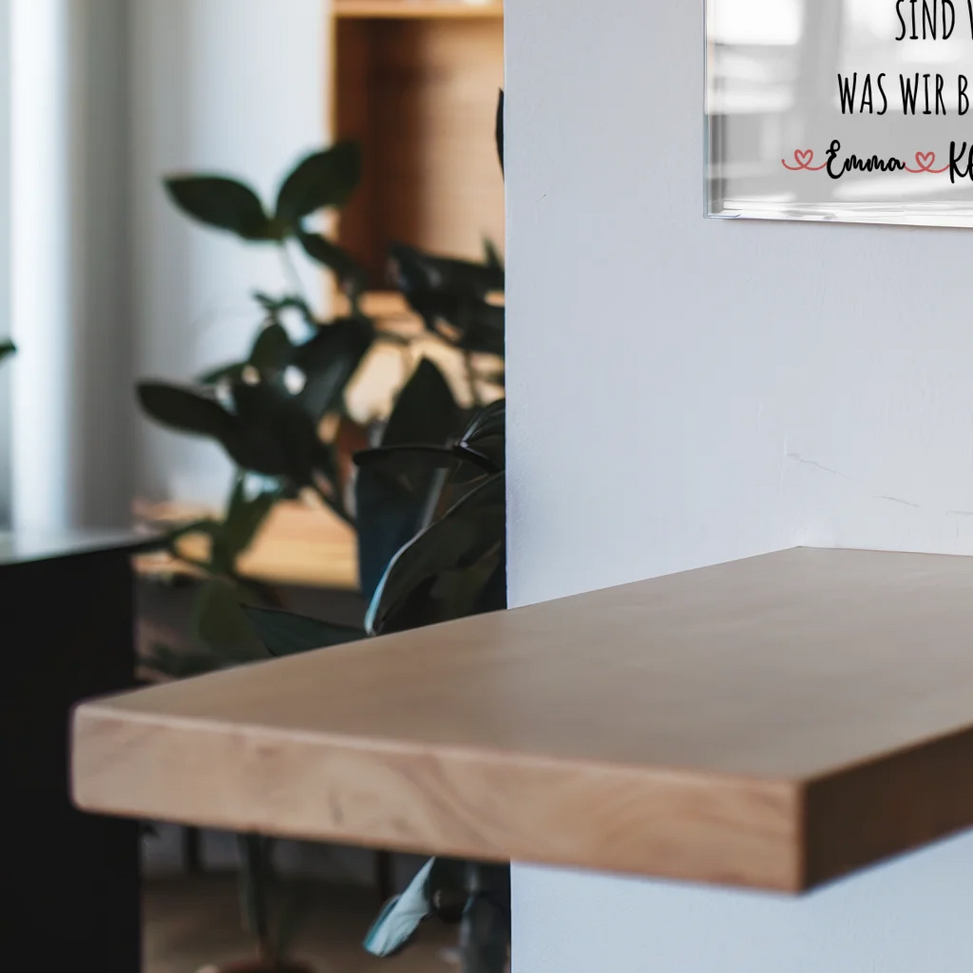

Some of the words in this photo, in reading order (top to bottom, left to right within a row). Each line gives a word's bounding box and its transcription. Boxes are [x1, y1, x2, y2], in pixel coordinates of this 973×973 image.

[837, 72, 888, 116] WAS
[899, 72, 947, 116] WIR
[825, 139, 906, 180] Emma
